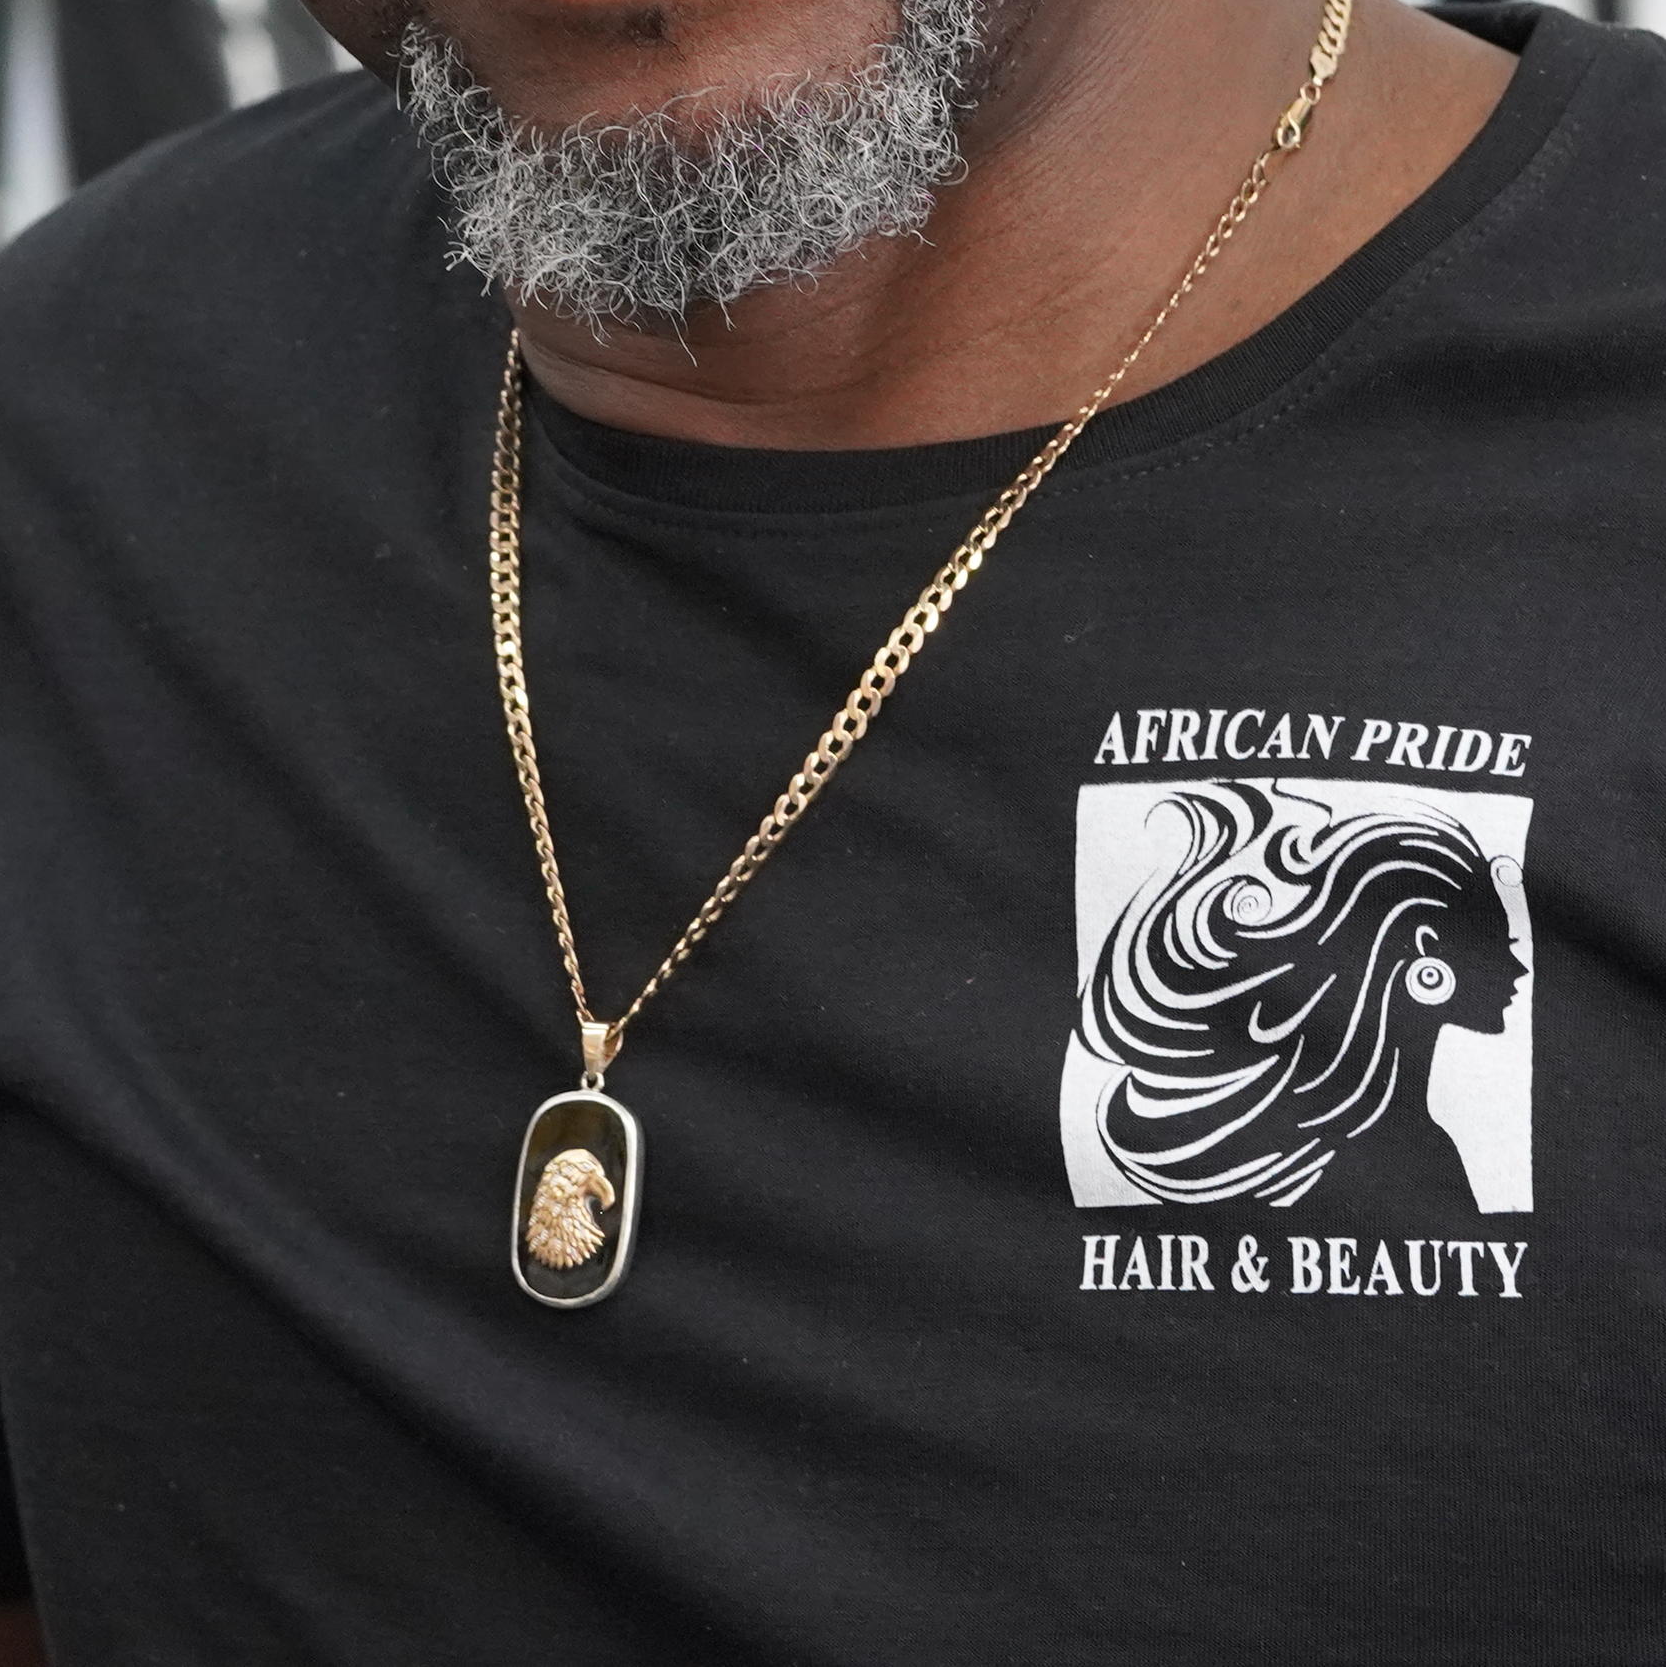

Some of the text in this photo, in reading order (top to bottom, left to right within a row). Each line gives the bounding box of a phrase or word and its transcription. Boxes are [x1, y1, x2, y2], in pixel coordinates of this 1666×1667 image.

[1093, 708, 1533, 778] AFRICAN PRIDE
[1079, 1234, 1529, 1299] HAIR & BEAUTY
